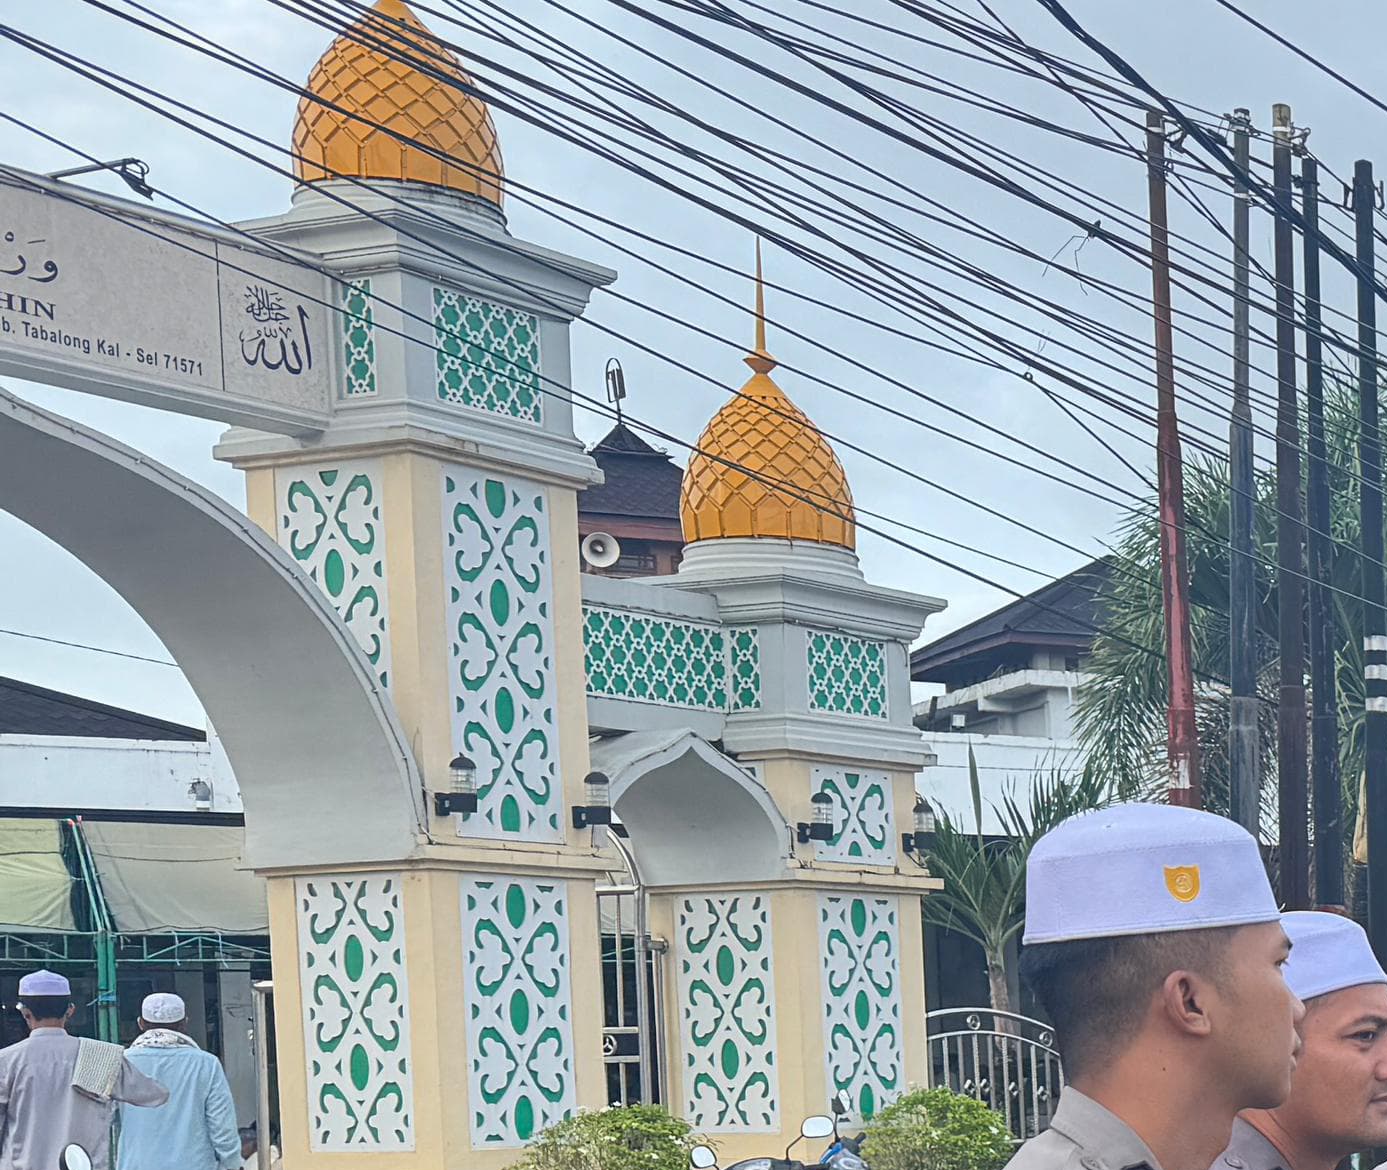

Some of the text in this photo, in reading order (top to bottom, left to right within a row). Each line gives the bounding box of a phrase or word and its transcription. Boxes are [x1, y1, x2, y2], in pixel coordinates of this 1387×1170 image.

[22, 321, 90, 354] Tabalong
[97, 339, 120, 358] Kal
[137, 347, 158, 366] Sel
[163, 354, 203, 376] 71571
